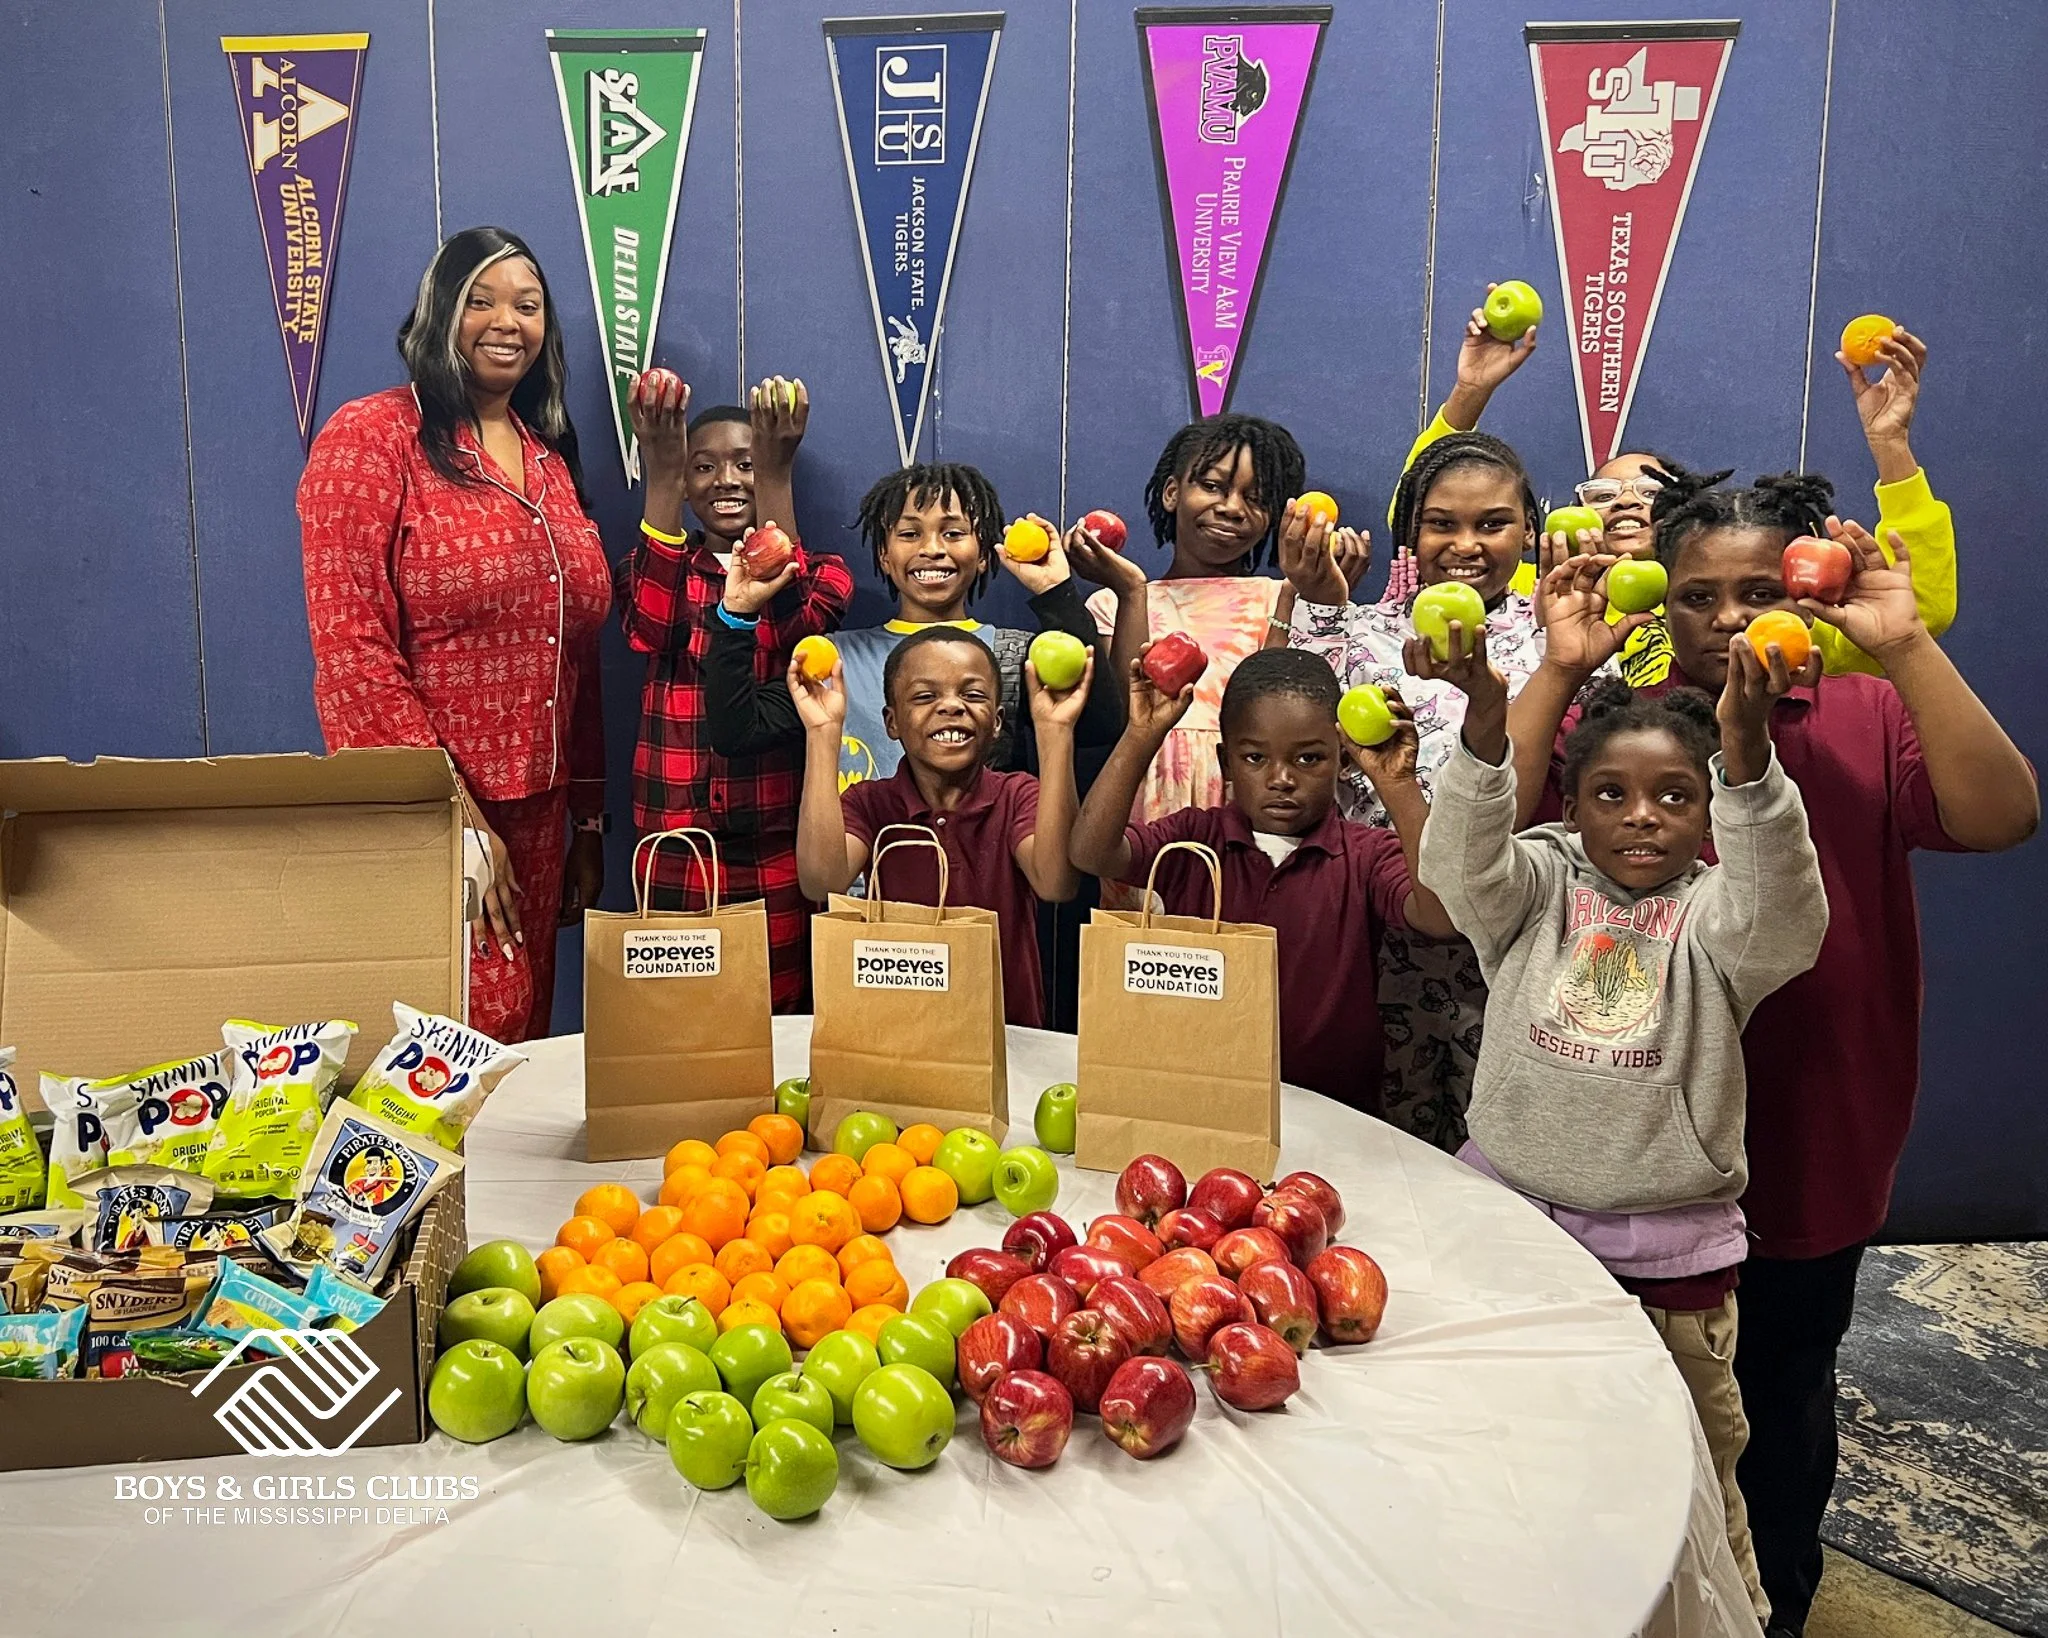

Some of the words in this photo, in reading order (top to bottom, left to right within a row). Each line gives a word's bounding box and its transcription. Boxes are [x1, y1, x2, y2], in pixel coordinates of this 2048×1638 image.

[279, 57, 297, 170] ALCORN
[1200, 36, 1240, 143] PVAMU
[294, 173, 322, 269] ALCORN
[912, 176, 926, 253] JACKSON
[1221, 156, 1247, 226] PRAIRIE
[280, 183, 304, 332] UNIVERSITY
[613, 224, 640, 301] DELTA
[1191, 192, 1218, 294] UNIVERSITY
[1217, 231, 1243, 281] VIEW
[1608, 212, 1632, 285] TEXAS
[297, 274, 321, 344] STATE
[615, 302, 641, 380] STATE
[1215, 285, 1240, 329] A&M
[1581, 272, 1605, 354] TIGERS
[1600, 291, 1627, 413] SOUTHERN
[627, 962, 715, 974] FOUNDATION
[858, 974, 944, 987] FOUNDATION
[1128, 977, 1218, 995] FOUNDATION
[1136, 948, 1162, 957] THANK
[1164, 951, 1180, 959] YOU
[1183, 952, 1193, 960] TO
[1530, 1023, 1600, 1064] DESERT
[1612, 1049, 1663, 1068] VIBES
[137, 1081, 229, 1136] POP
[172, 1142, 211, 1157] ORIGIN
[91, 1335, 109, 1348] 100
